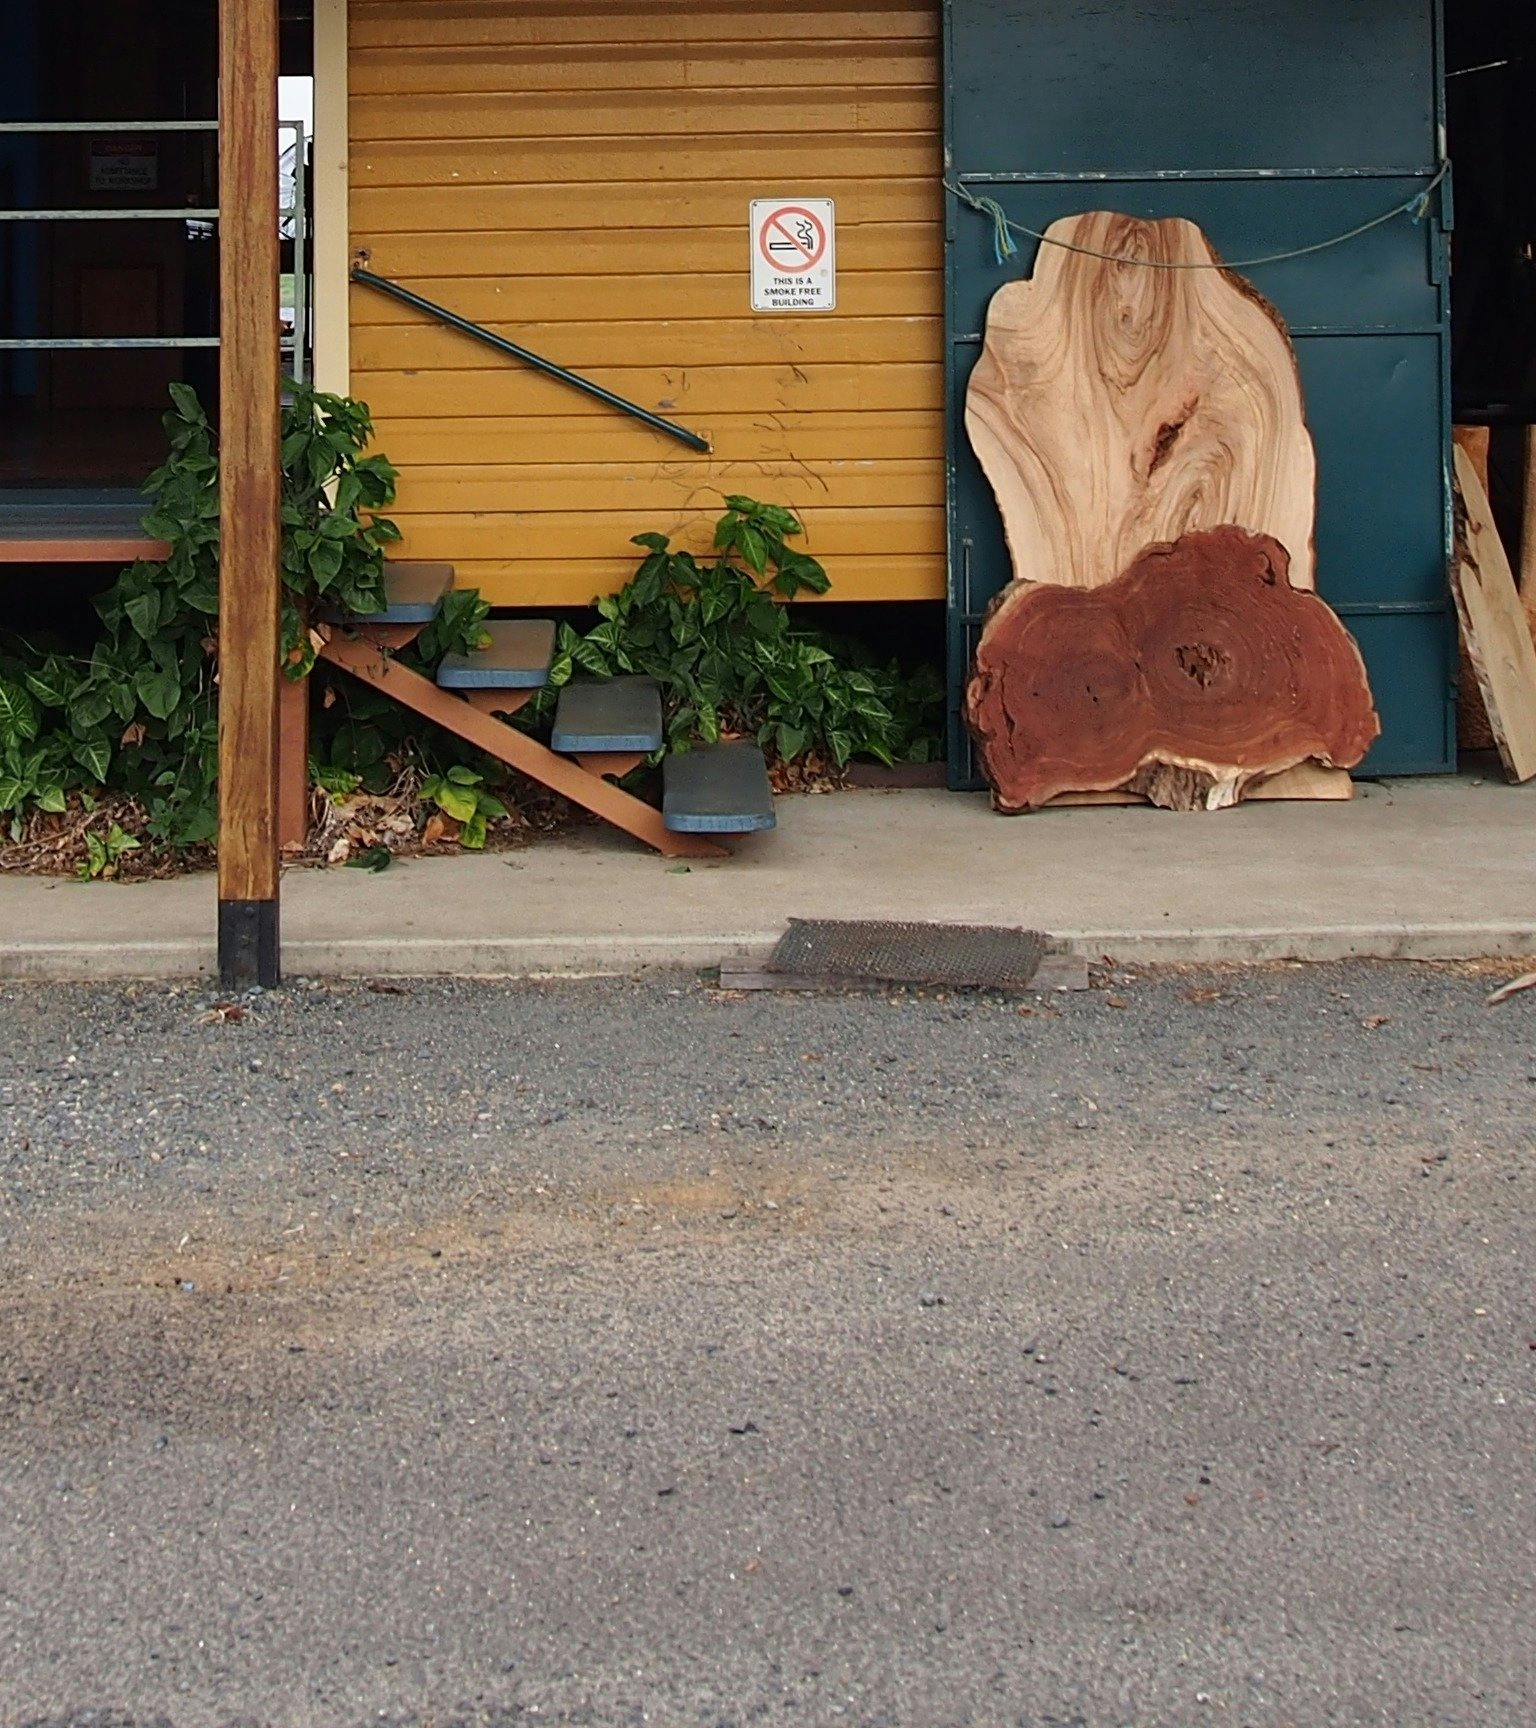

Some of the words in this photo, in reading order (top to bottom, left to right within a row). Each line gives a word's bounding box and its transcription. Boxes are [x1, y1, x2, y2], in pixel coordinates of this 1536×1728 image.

[774, 277, 793, 285] THIS
[795, 277, 804, 285] IS
[764, 288, 796, 296] SMOKE
[772, 298, 814, 306] BUILDING
